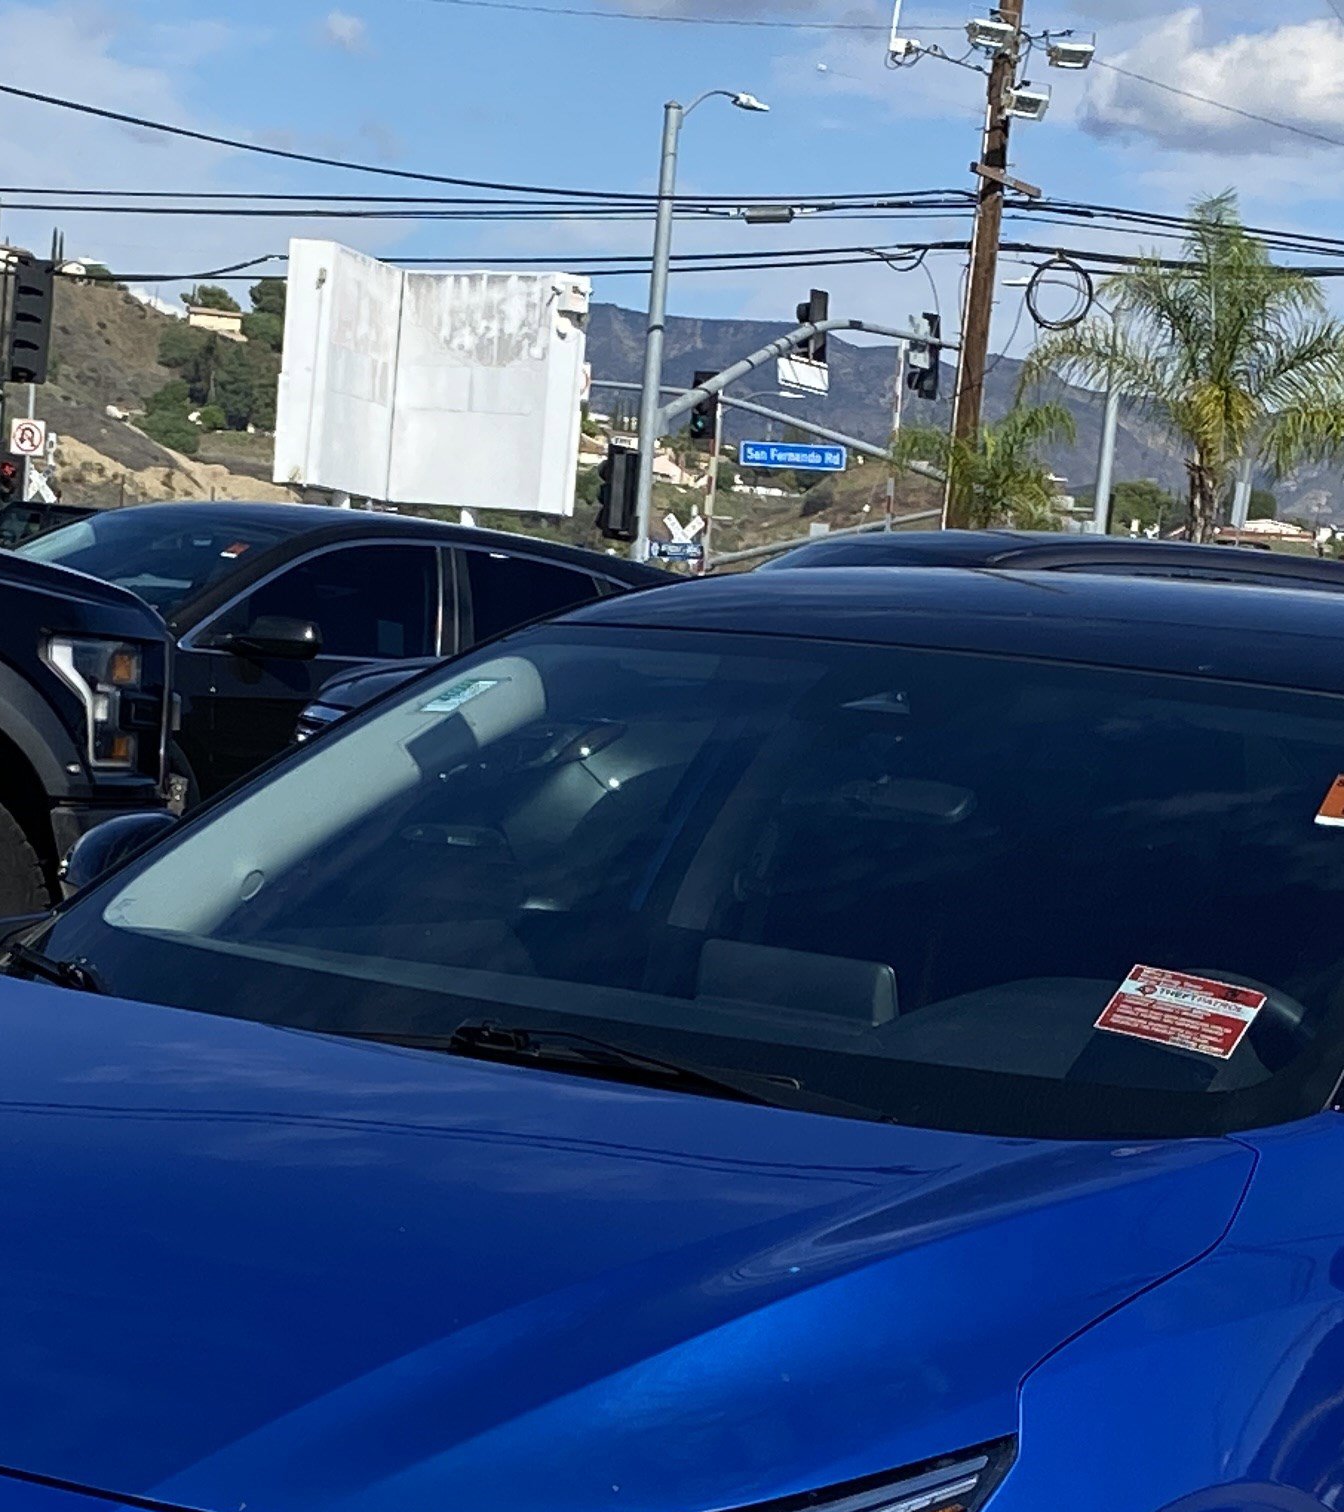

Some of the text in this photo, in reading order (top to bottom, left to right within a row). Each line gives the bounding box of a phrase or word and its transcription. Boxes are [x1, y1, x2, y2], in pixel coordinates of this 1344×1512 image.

[746, 447, 840, 465] San Fernando Rd
